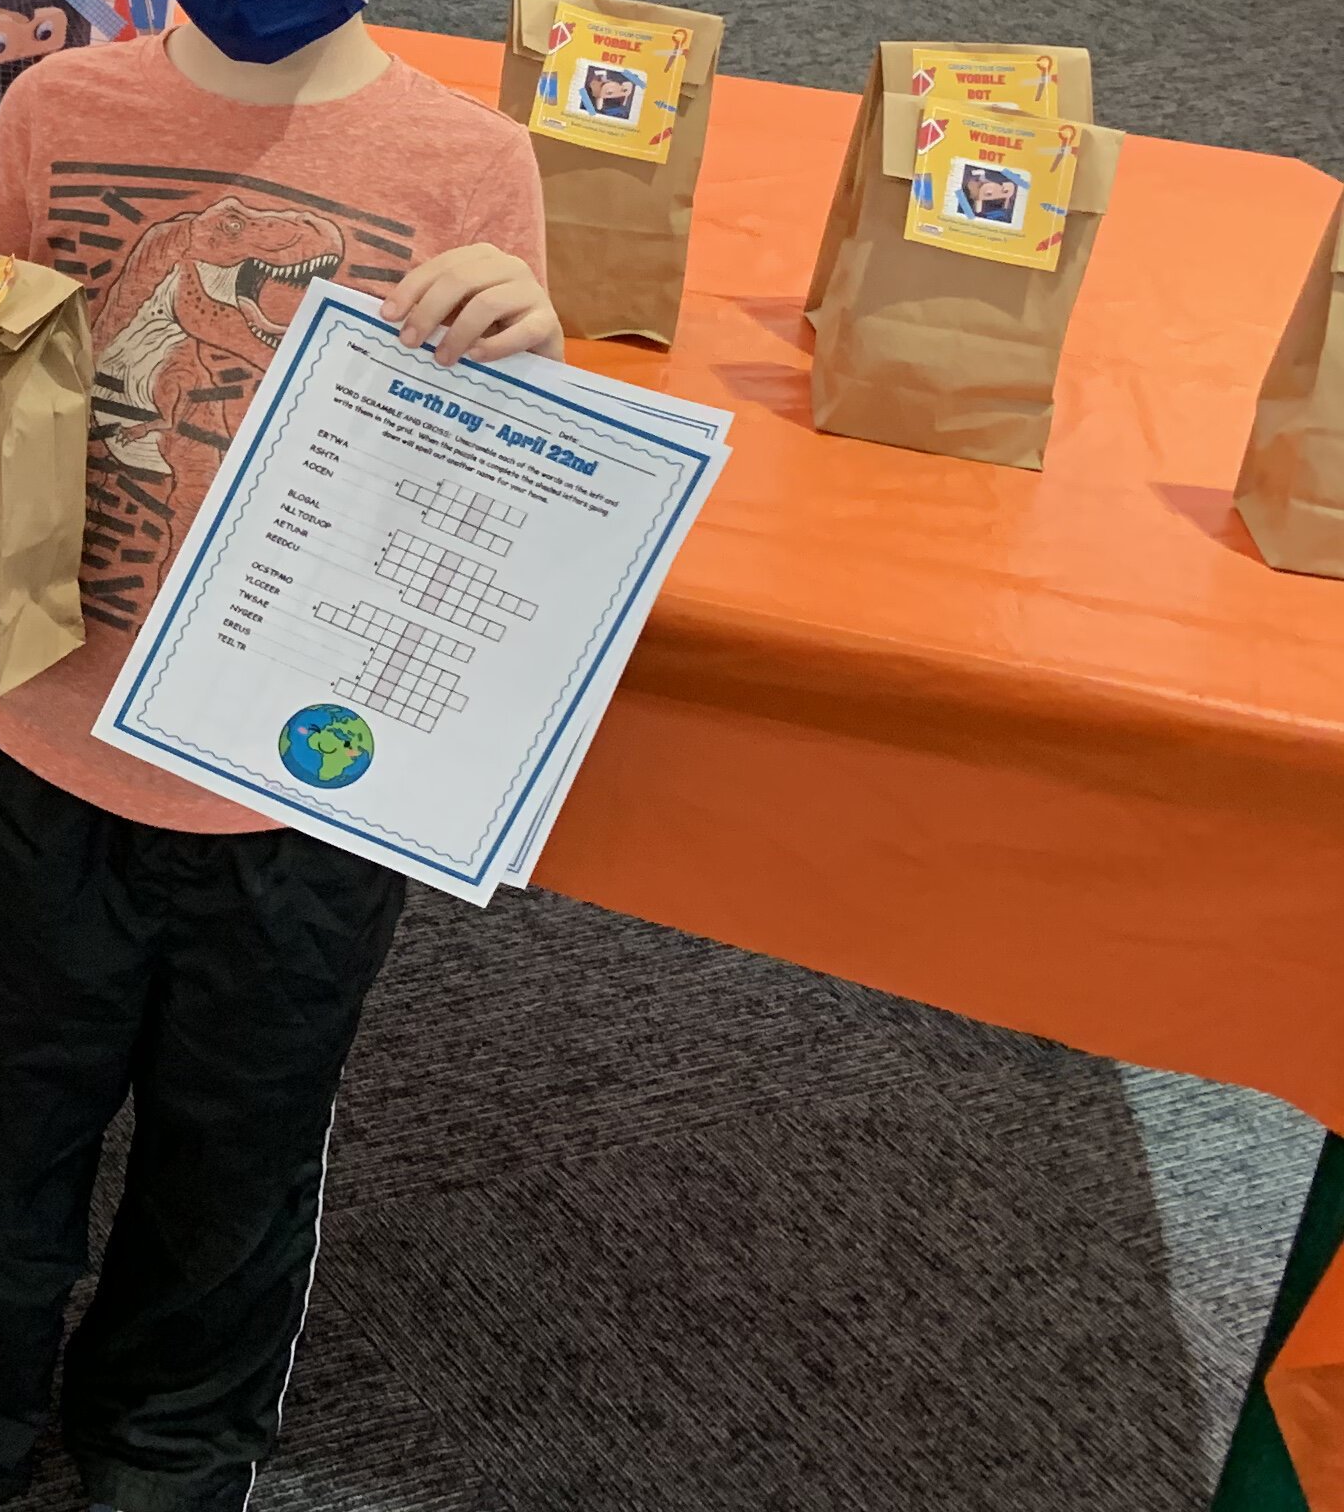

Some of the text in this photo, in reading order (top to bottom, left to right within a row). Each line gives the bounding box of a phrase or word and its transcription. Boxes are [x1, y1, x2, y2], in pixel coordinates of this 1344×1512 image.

[592, 33, 643, 53] WOBBLE
[601, 51, 627, 65] BOT
[956, 73, 1006, 85] WOBBLE
[967, 89, 992, 101] BOT
[969, 129, 1024, 151] WOBBLE
[978, 148, 1006, 164] BOT
[346, 340, 579, 444] Name: Date:
[387, 379, 444, 413] Earth
[442, 401, 483, 433] Day
[495, 423, 547, 455] April
[545, 444, 598, 476] 22nd
[317, 428, 348, 448] ERTWA
[334, 383, 360, 399] WORD
[360, 395, 403, 418] SCRAMBLE
[421, 421, 451, 438] CROSS:
[454, 434, 497, 457] Unscramble
[497, 453, 516, 465] each
[540, 472, 563, 485] words
[588, 490, 604, 500] left
[309, 443, 339, 462] RSHTA
[332, 396, 353, 409] write
[354, 405, 373, 418] them
[417, 431, 439, 445] When
[452, 447, 477, 462] puzzle
[485, 461, 520, 479] complete
[534, 481, 562, 496] shaded
[561, 491, 588, 507] letters
[587, 503, 609, 517] going
[381, 430, 401, 441] down
[401, 439, 415, 447] will
[414, 444, 433, 455] spell
[446, 457, 475, 472] another
[475, 469, 495, 481] name
[509, 483, 527, 493] your
[302, 459, 334, 477] ACCEN
[287, 488, 319, 509] BLOGAL
[272, 518, 308, 537] AETUNR
[265, 531, 300, 551] REEDCU
[251, 561, 293, 584] OCSTPMO
[245, 574, 280, 595] YLCCEER
[239, 588, 269, 608] TWSAE
[229, 603, 263, 623] NYGEER
[222, 617, 250, 635] EREUS
[217, 632, 246, 651] TEILTR
